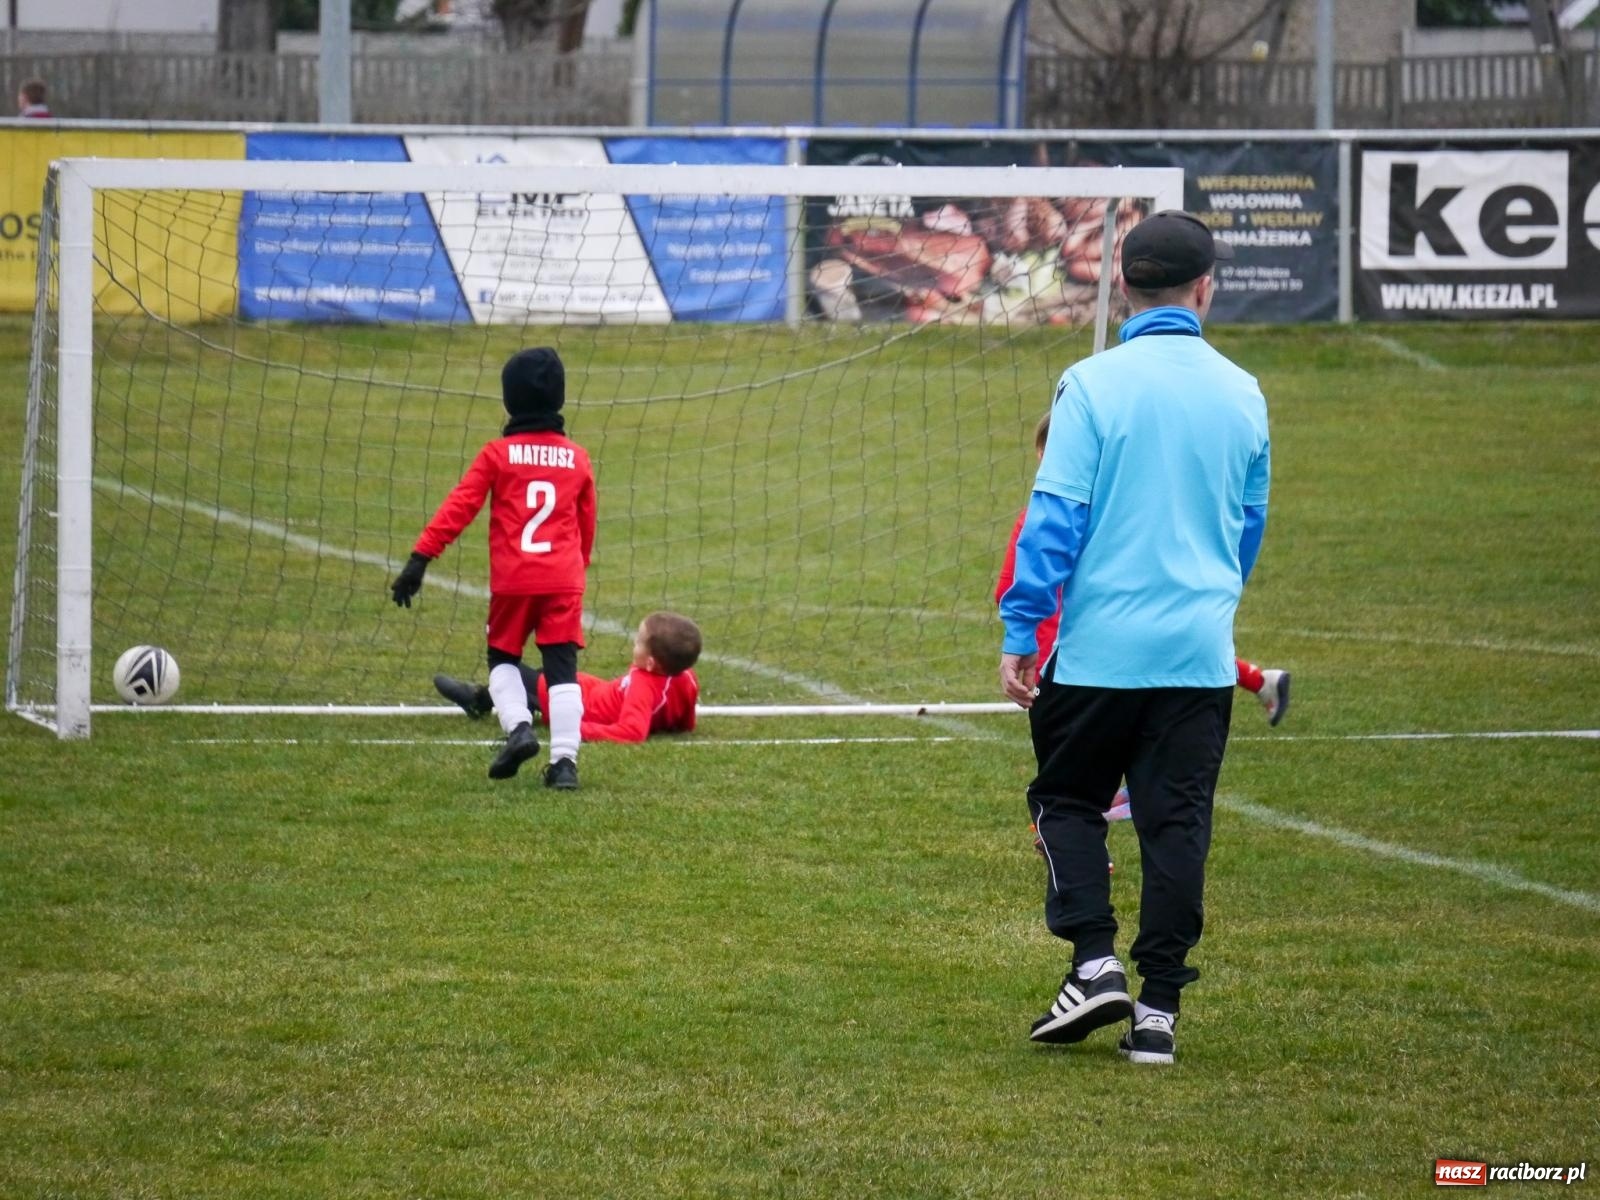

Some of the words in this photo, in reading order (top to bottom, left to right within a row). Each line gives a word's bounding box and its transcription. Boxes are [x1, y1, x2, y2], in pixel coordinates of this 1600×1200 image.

[1197, 175, 1316, 191] WIEPRZOWINA
[1208, 193, 1303, 209] WOŁOWINA
[1388, 162, 1600, 259] ke
[1381, 283, 1557, 309] WWW.KEEZA.PL
[508, 443, 575, 470] MATEUSZ
[520, 480, 556, 553] 2
